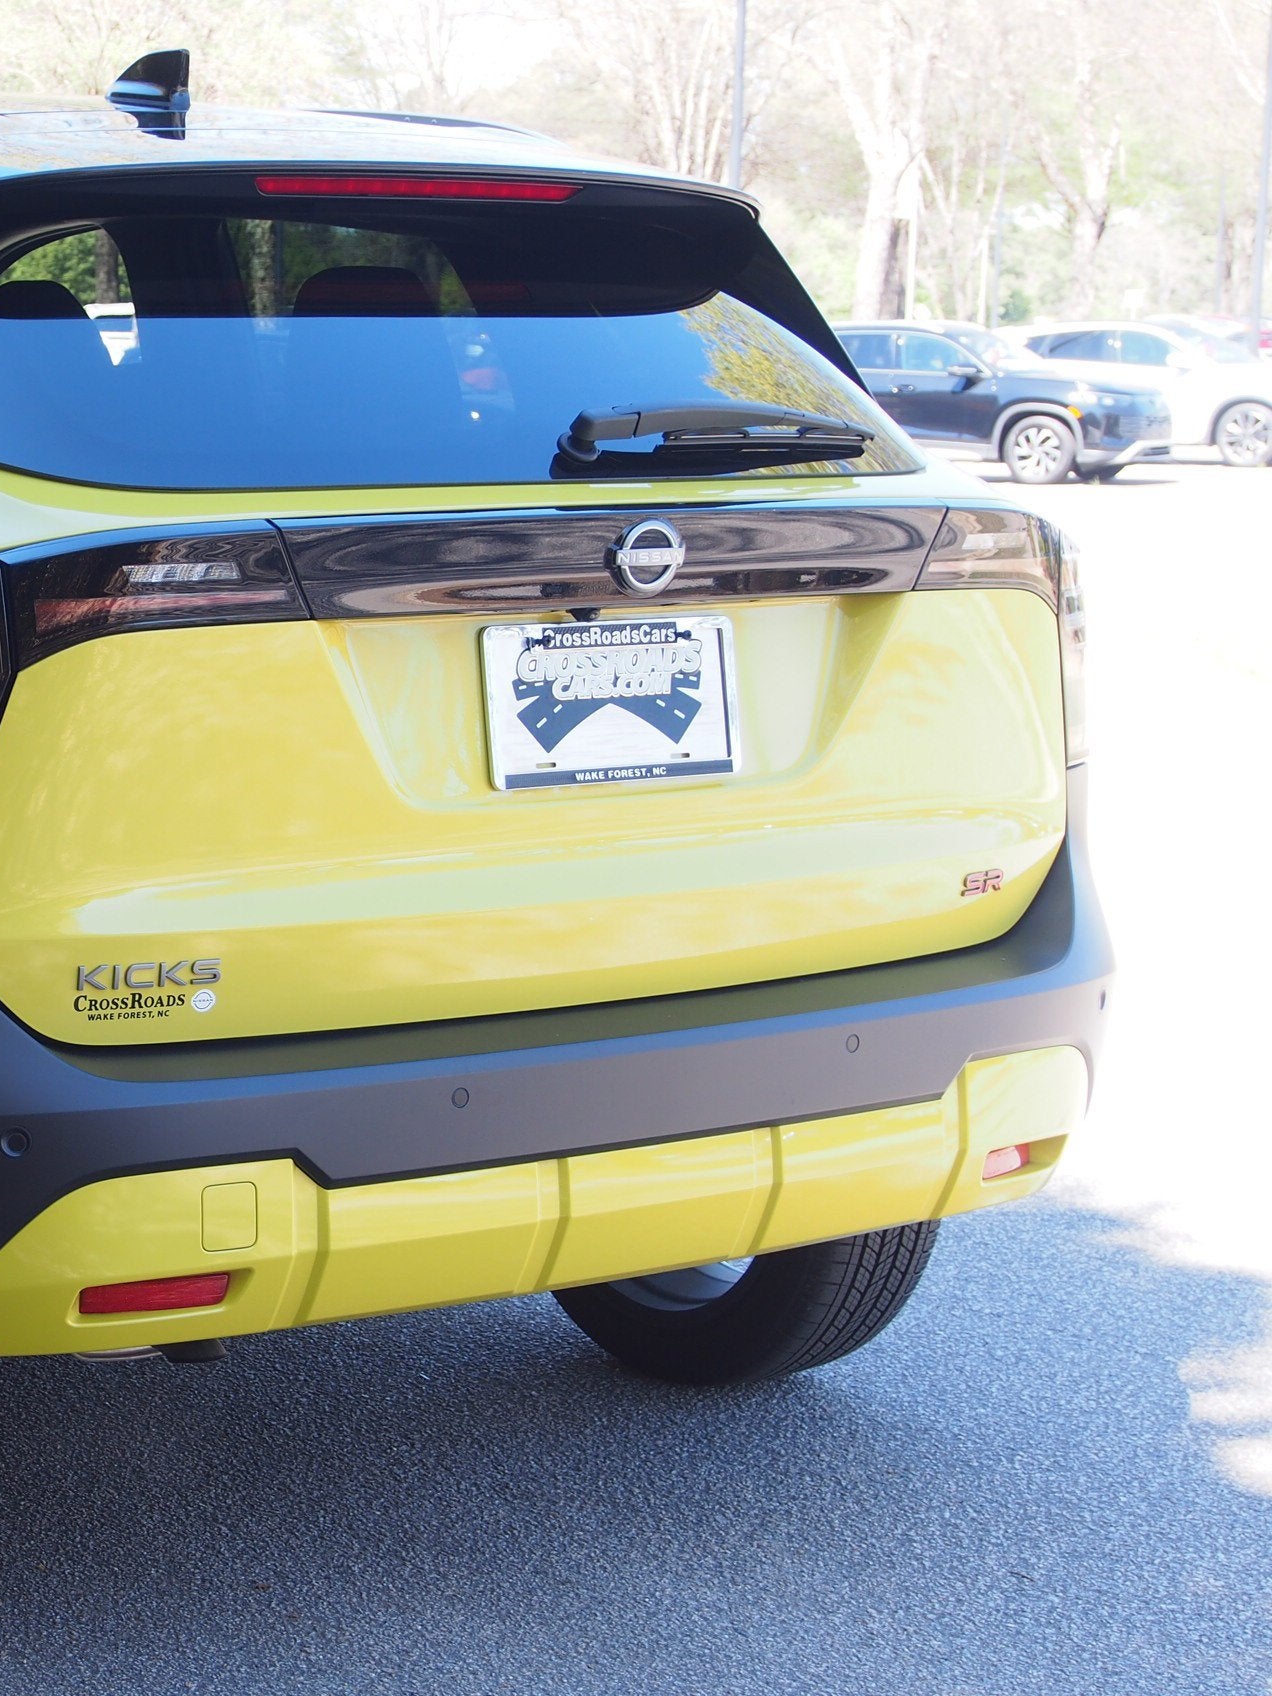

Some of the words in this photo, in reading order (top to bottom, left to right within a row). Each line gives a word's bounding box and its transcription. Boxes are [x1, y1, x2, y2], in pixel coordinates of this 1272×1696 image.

[617, 551, 683, 564] NISSAN
[543, 625, 676, 648] CrossRoadsCars
[517, 638, 702, 682] CROSSROADS
[552, 672, 672, 700] CARS.COM
[575, 770, 605, 781] WAKE
[608, 768, 650, 779] FOREST,
[652, 766, 666, 775] NC
[960, 868, 1004, 897] SR
[76, 958, 222, 992] KICKS
[87, 1012, 115, 1021] WAKE
[117, 1010, 155, 1020] FOREST,
[157, 1010, 170, 1018] NC
